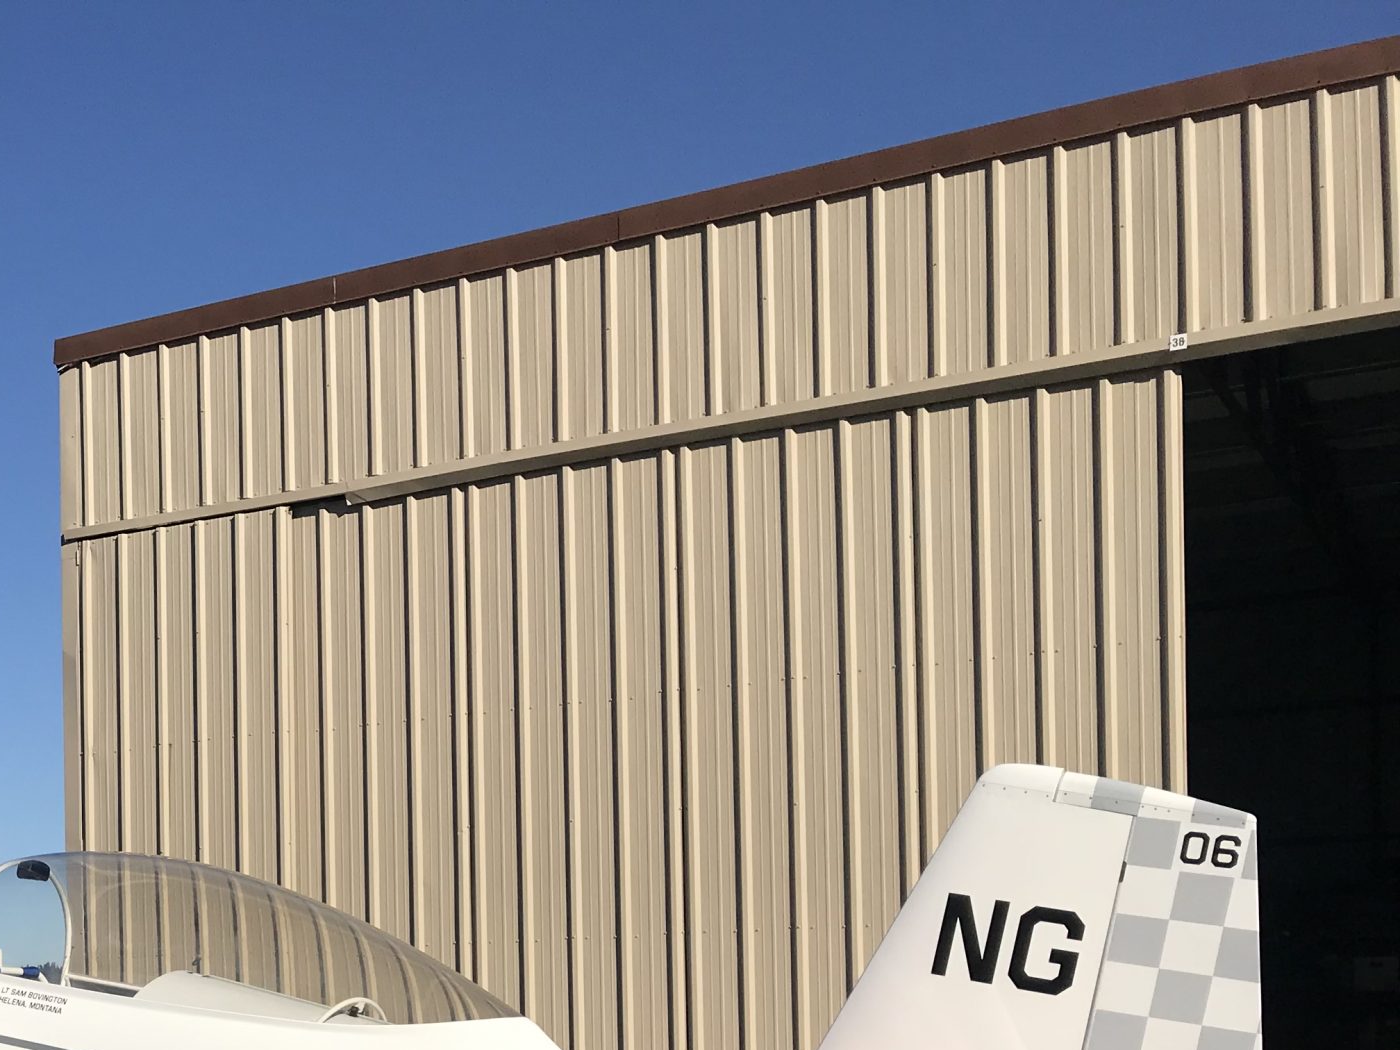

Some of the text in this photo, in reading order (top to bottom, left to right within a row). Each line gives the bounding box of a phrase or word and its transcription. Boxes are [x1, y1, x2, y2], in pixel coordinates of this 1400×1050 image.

[1180, 831, 1242, 869] 06
[931, 892, 1086, 996] NG
[11, 988, 27, 997] SAM
[28, 991, 68, 1005] BOVINGTON
[29, 1001, 62, 1014] MONTANA
